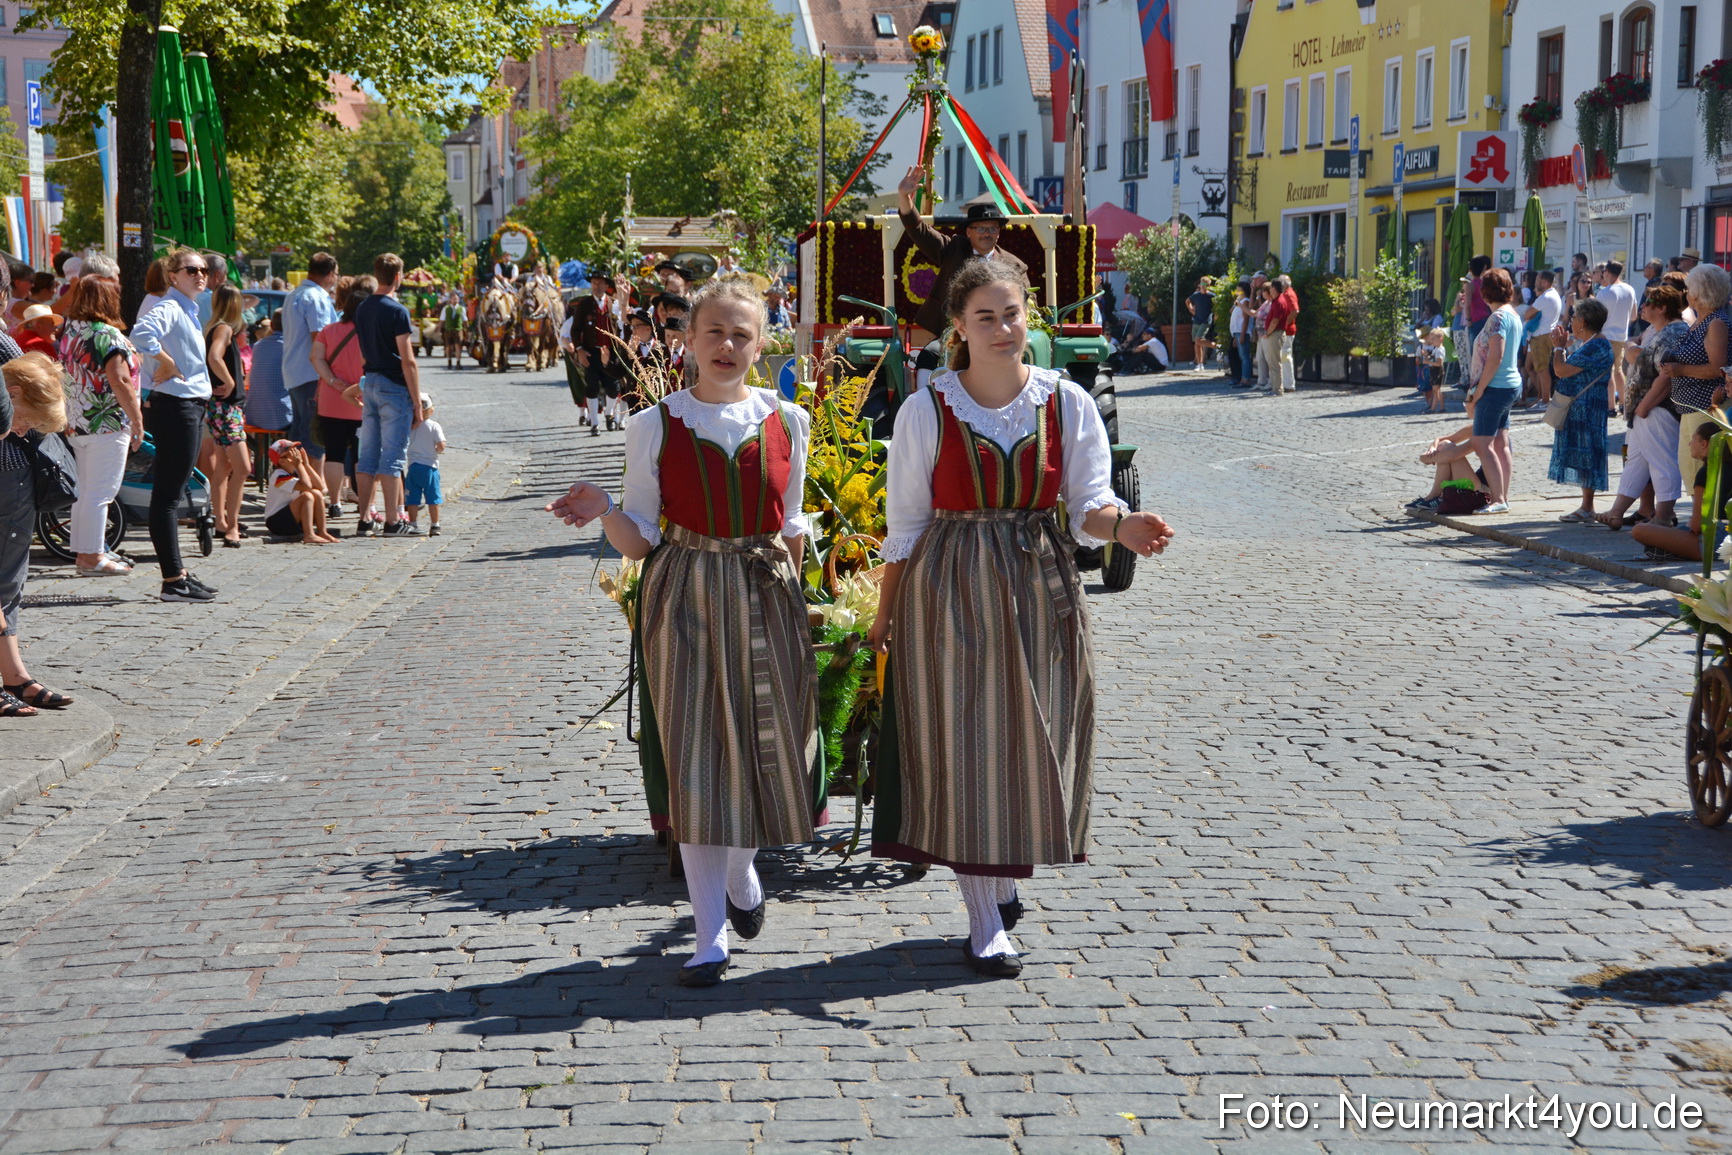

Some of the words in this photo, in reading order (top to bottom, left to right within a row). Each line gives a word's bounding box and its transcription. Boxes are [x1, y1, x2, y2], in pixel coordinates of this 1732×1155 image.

[1292, 36, 1323, 69] HOTEL
[1331, 30, 1366, 58] Lehmeier
[1326, 166, 1364, 175] TAIFN
[1395, 149, 1402, 180] P
[1404, 150, 1431, 171] AIFUN
[1286, 181, 1329, 202] Restaurant
